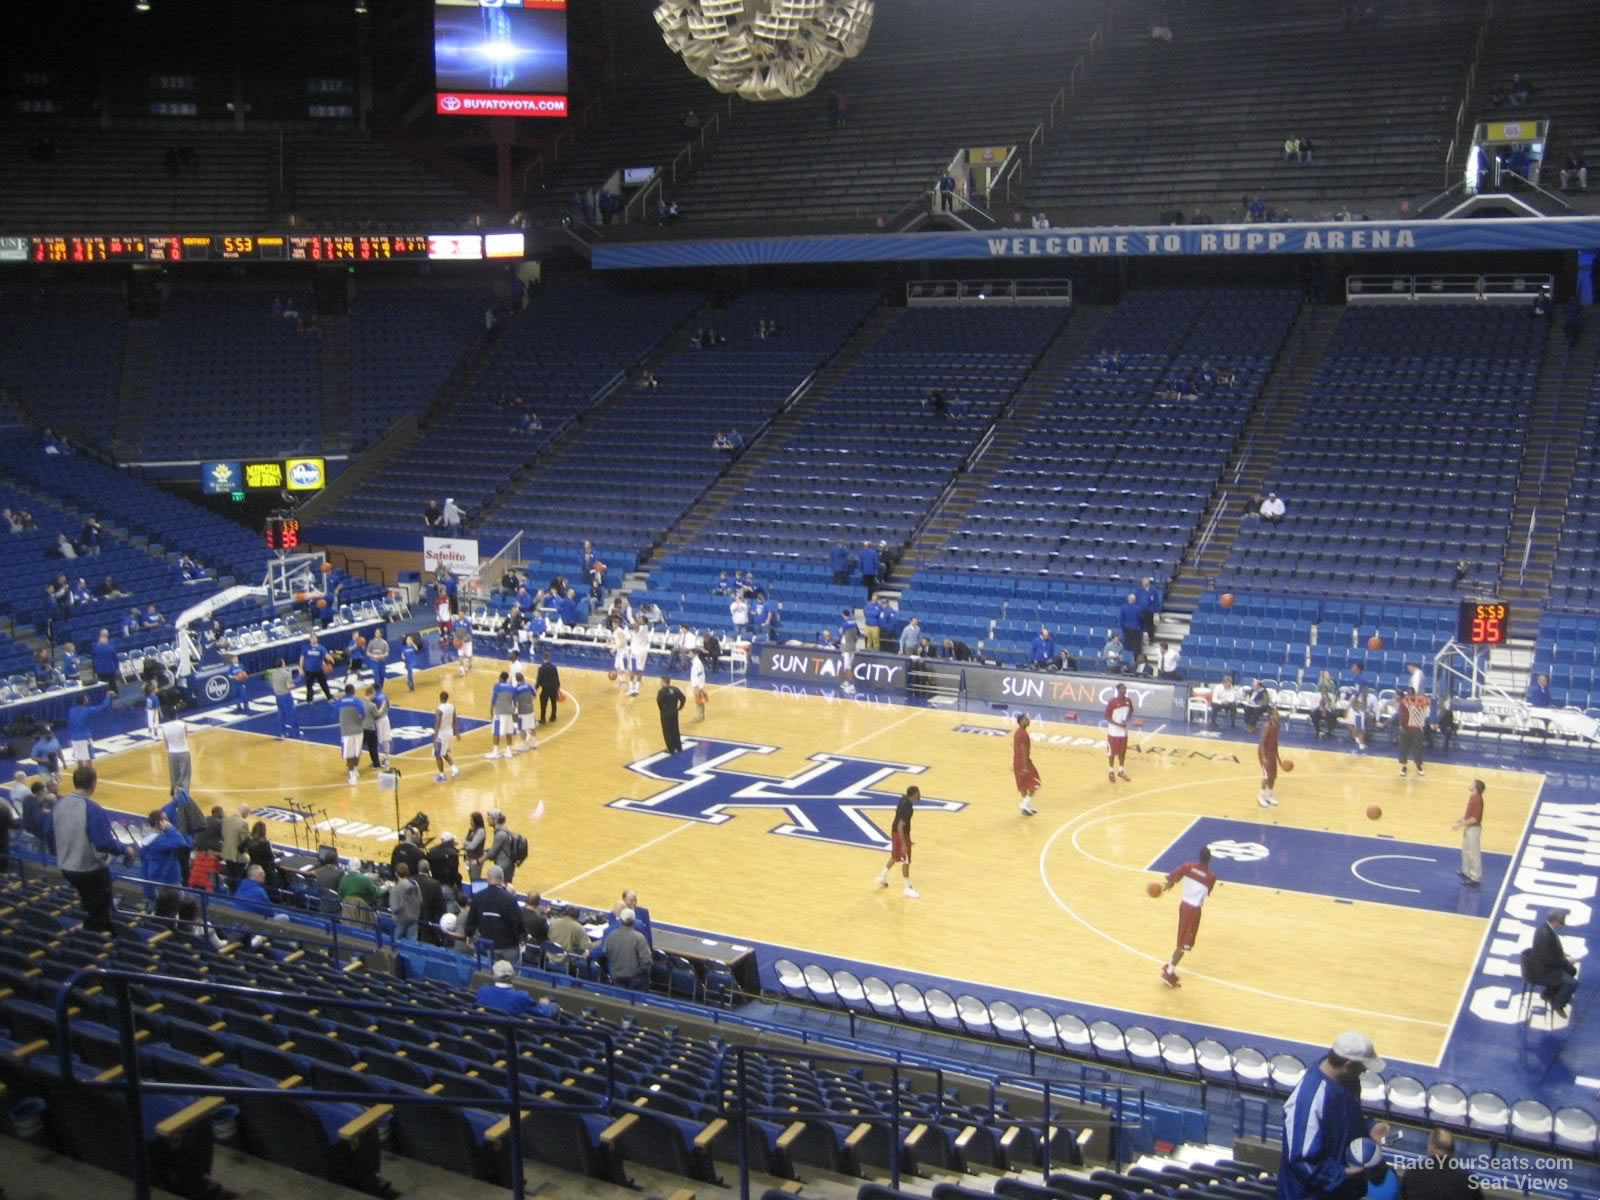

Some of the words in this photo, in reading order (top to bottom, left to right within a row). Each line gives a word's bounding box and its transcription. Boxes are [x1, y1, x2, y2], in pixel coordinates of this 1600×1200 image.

[463, 99, 565, 110] BUYATOYOTA.COM
[988, 236, 1128, 255] WELCOME
[1146, 235, 1181, 252] TO
[1202, 232, 1286, 251] RUPP
[1304, 229, 1416, 249] ARENA
[425, 550, 466, 562] Safelite
[1476, 605, 1505, 619] 5:53
[1471, 619, 1500, 642] 35
[771, 653, 808, 674] SUN
[854, 662, 900, 683] CITY
[1002, 676, 1044, 699] SUN
[1050, 681, 1096, 703] TAN
[1127, 743, 1242, 765] ARENA
